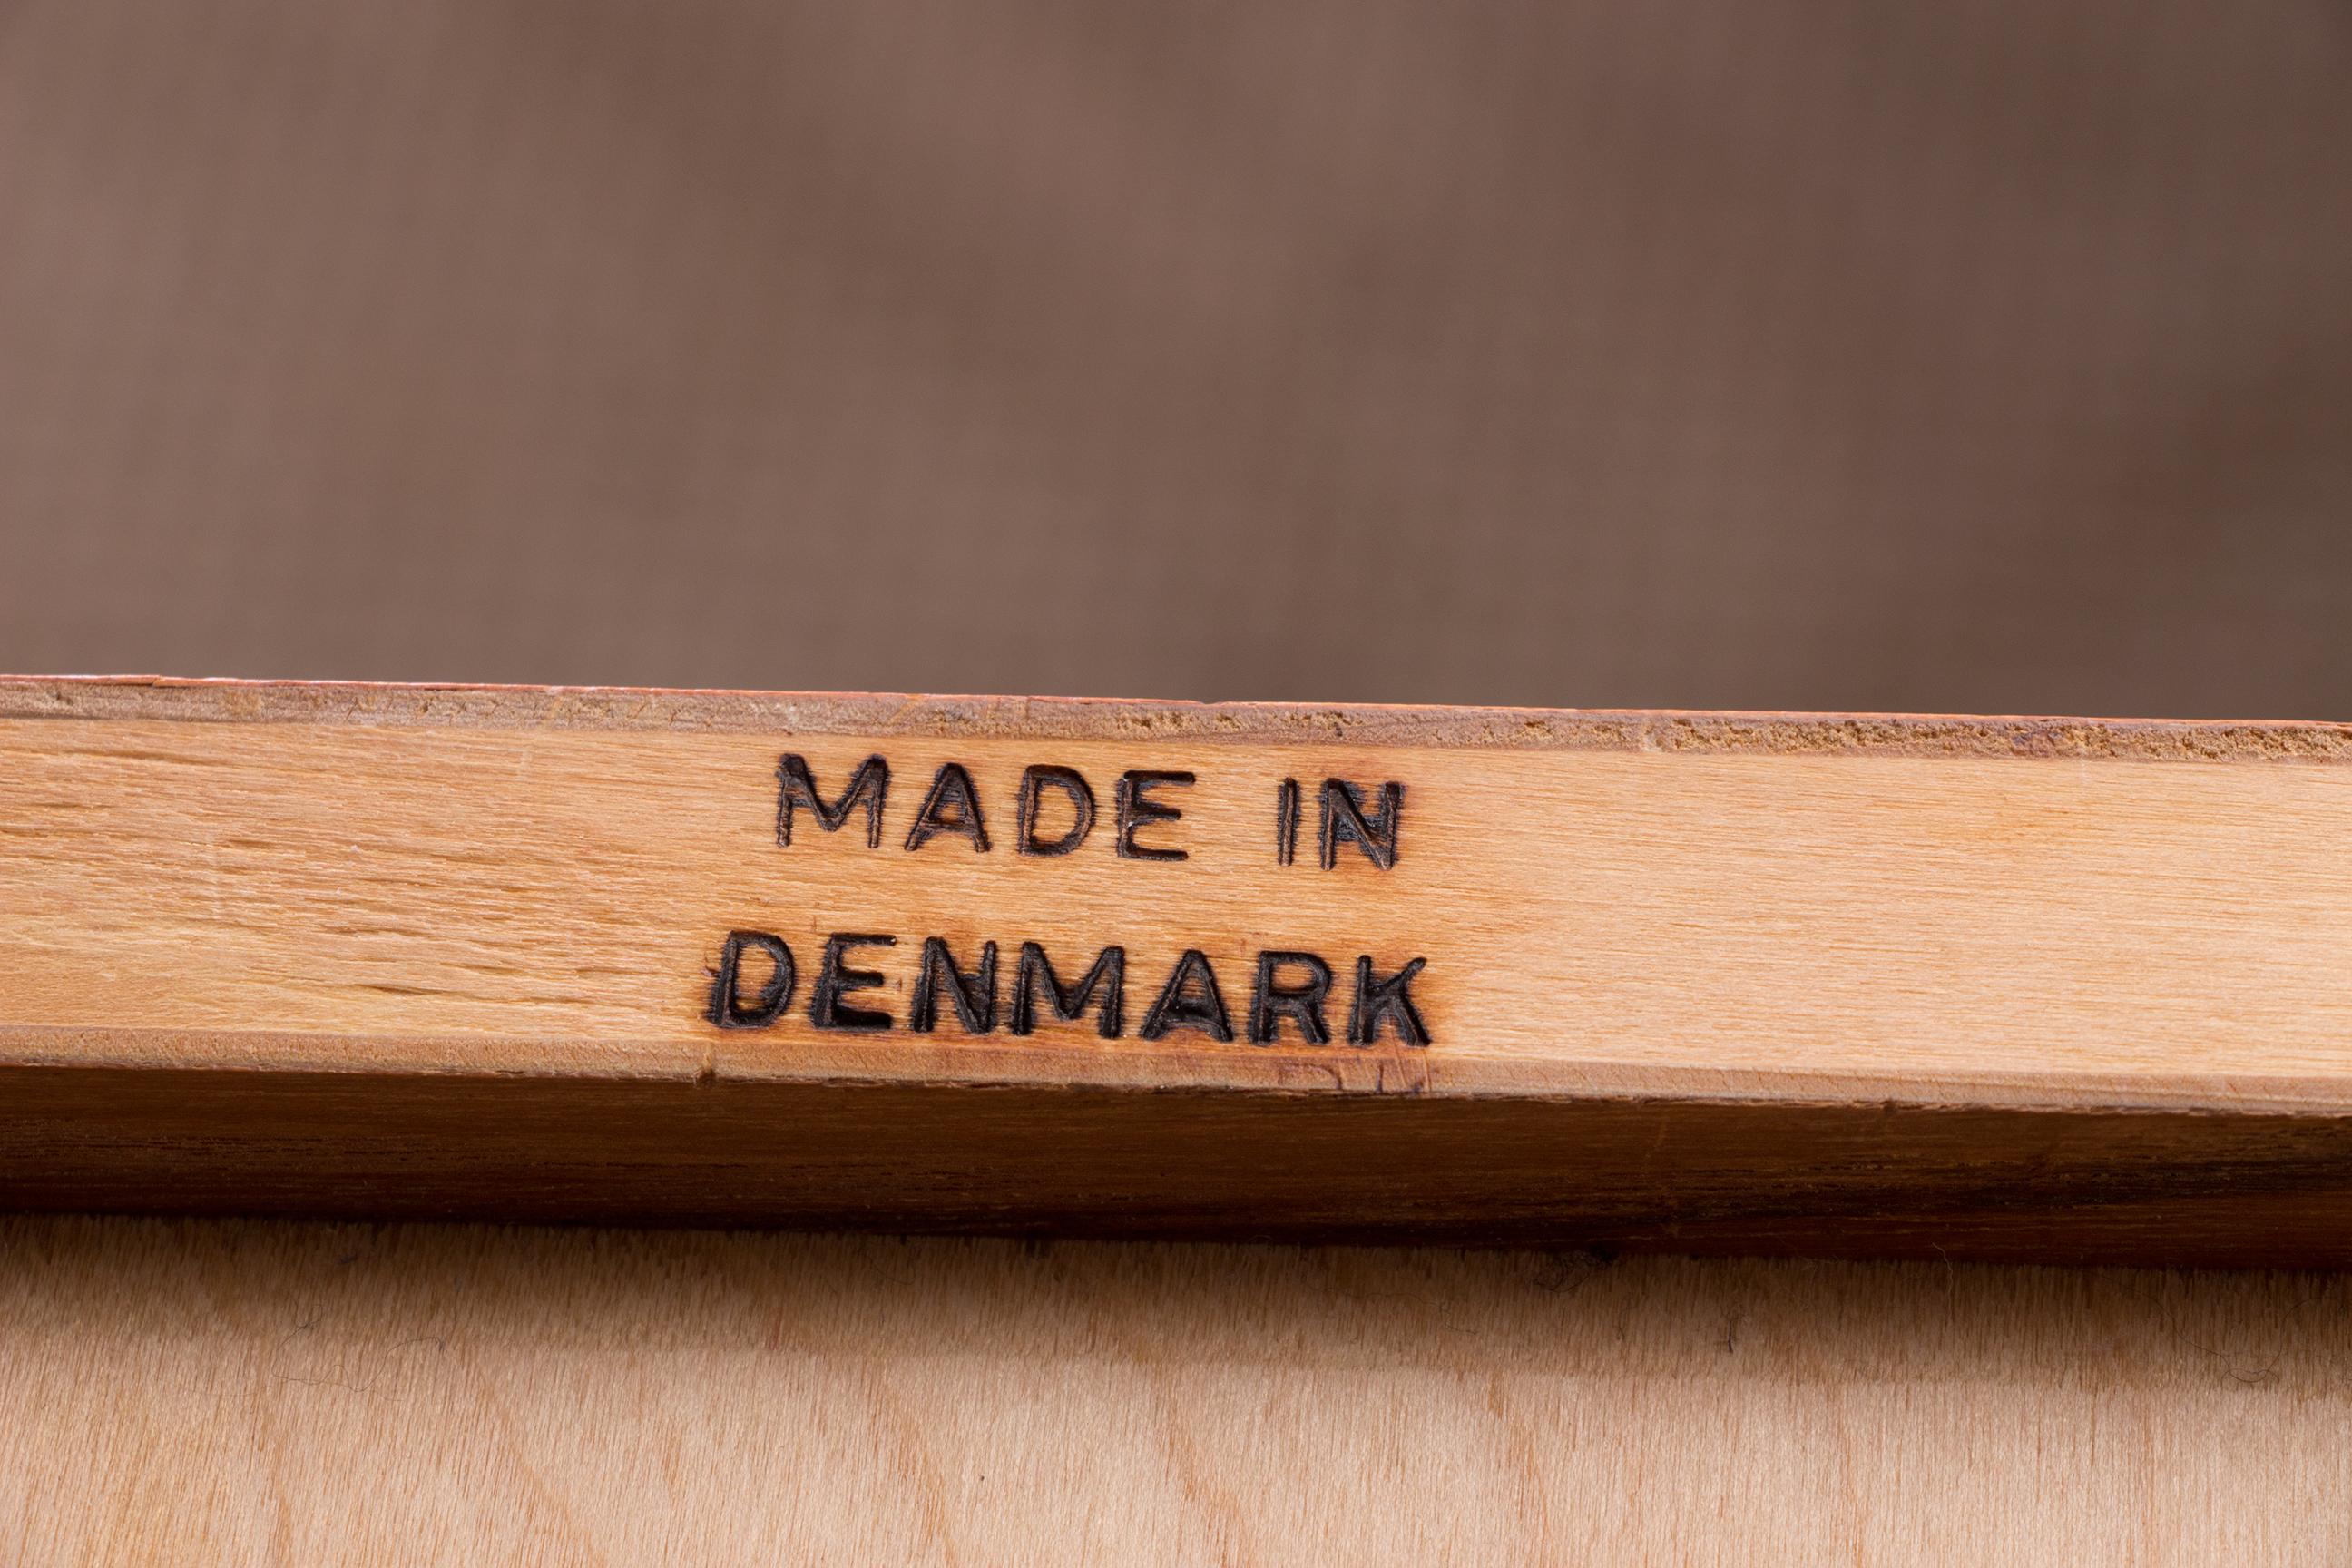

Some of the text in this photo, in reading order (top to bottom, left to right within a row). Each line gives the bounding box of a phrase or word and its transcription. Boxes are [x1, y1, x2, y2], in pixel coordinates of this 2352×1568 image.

[775, 752, 1407, 872] MADE IN
[703, 928, 1434, 1050] DENMARK
